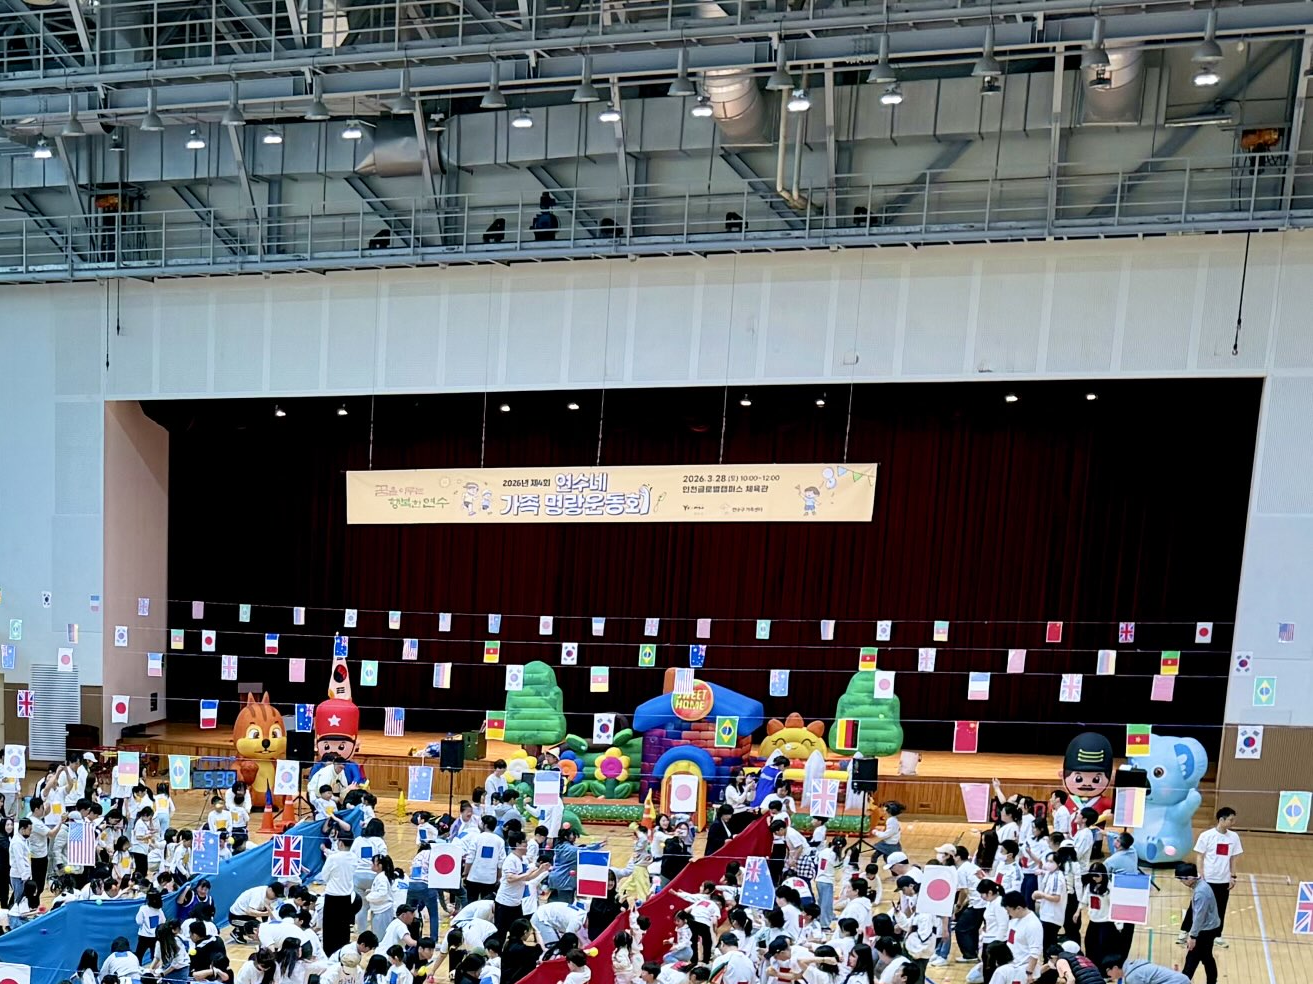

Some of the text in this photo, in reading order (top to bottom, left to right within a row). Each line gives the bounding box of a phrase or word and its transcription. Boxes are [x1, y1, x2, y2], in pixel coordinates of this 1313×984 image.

[502, 472, 608, 493] 2026년 제4회 연수네
[682, 484, 769, 493] 인천글로벌캠퍼스 체육관
[423, 496, 450, 509] 연수
[500, 488, 651, 516] 가족 명랑운동회
[675, 699, 705, 710] HOME
